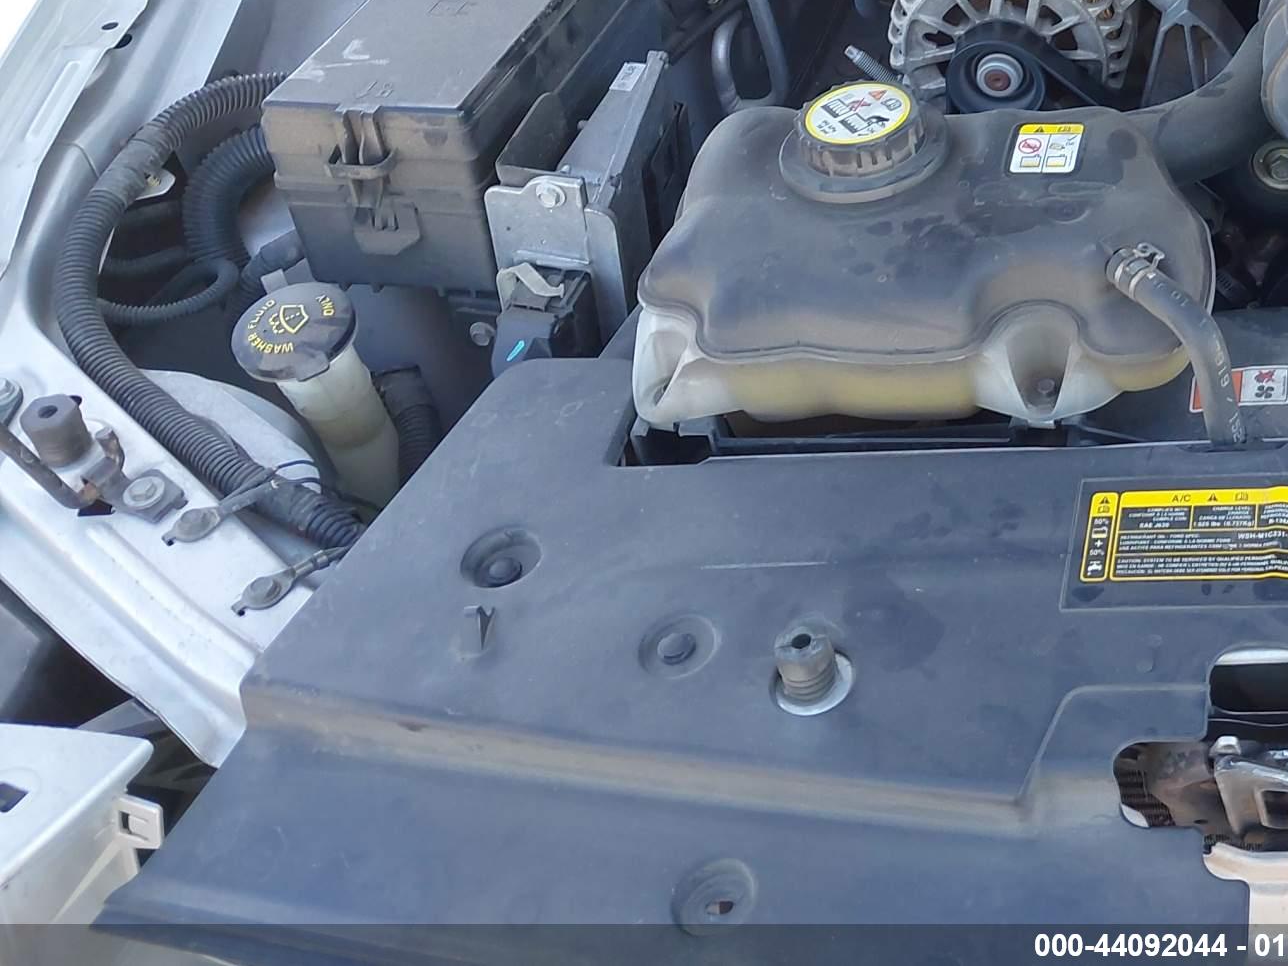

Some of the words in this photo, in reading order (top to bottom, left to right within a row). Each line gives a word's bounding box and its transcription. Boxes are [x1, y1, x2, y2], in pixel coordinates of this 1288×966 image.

[247, 299, 275, 330] FLUID
[315, 294, 335, 317] ONLY
[247, 334, 294, 354] WASHER
[1171, 494, 1191, 502] A/C
